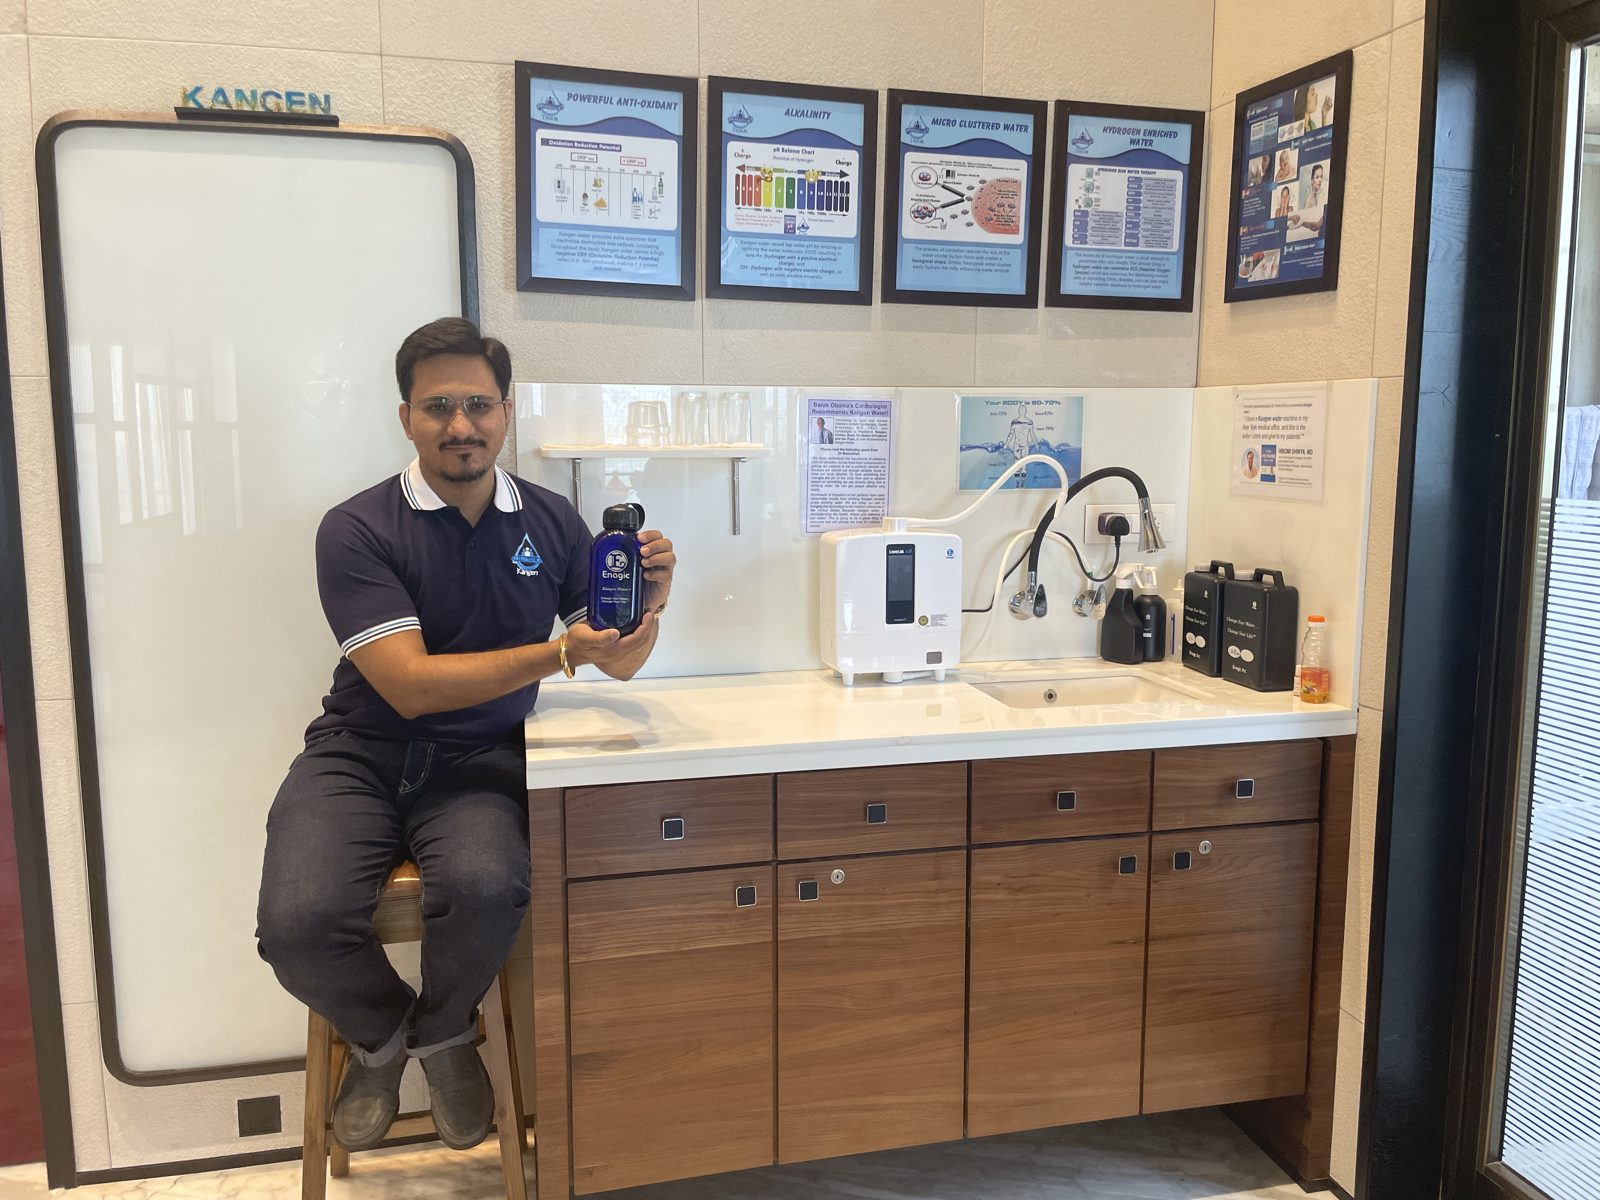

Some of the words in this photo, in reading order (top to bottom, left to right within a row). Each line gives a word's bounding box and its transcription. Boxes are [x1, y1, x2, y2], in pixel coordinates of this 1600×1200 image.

[567, 92, 614, 105] POWERFUL
[617, 98, 679, 111] ANTI-OXIDANT
[785, 108, 832, 120] ALKALINITY
[932, 118, 957, 127] MICRO
[959, 120, 1001, 131] CLUSTERED
[1004, 123, 1029, 133] WATER
[1103, 126, 1142, 136] HYDROGEN
[1143, 129, 1179, 139] ENRICHED
[1130, 138, 1154, 148] WATER
[734, 152, 752, 160] Charge
[517, 568, 539, 577] Kangen
[602, 570, 630, 581] Enagic
